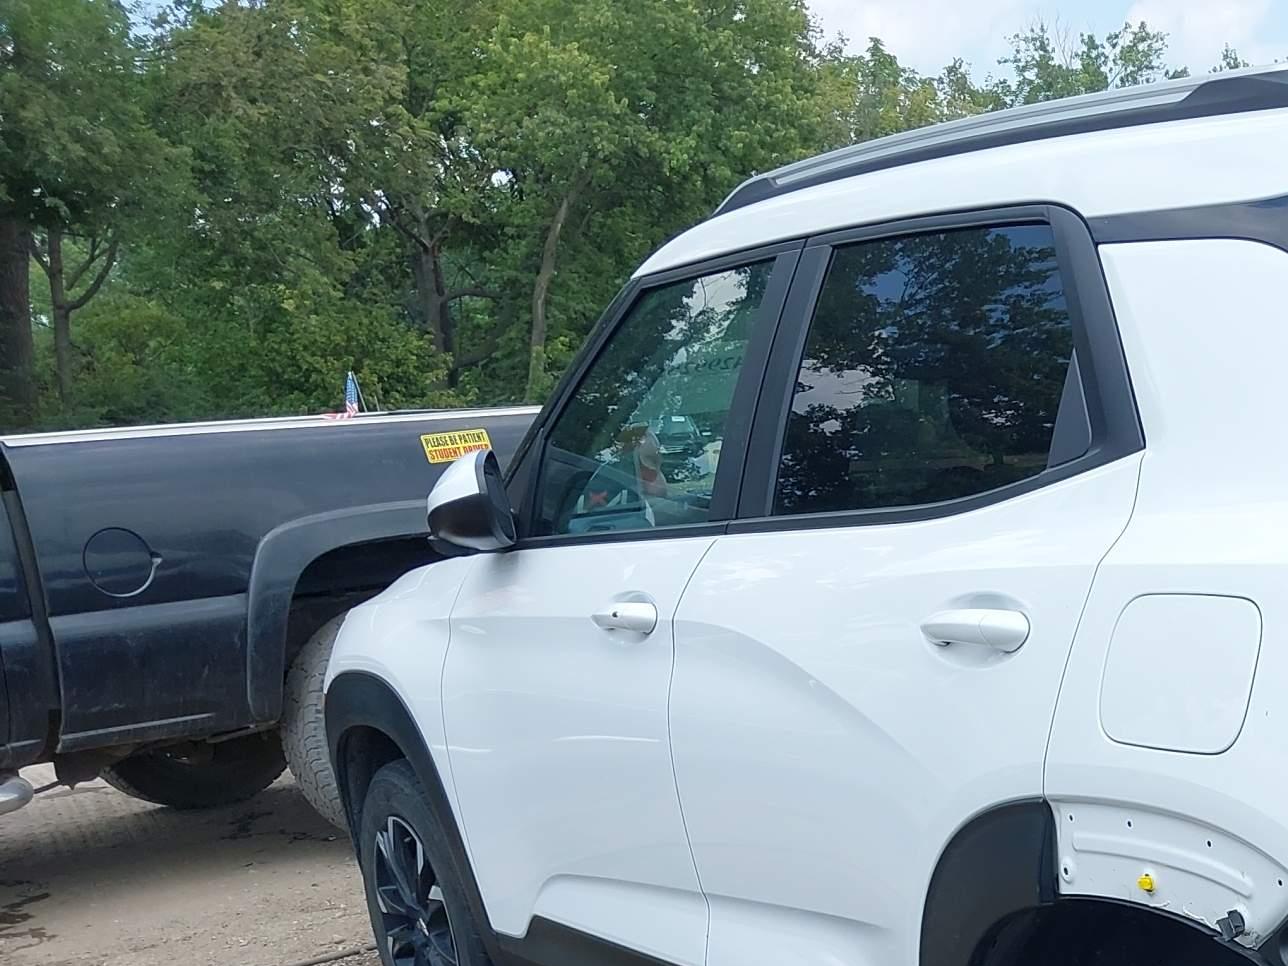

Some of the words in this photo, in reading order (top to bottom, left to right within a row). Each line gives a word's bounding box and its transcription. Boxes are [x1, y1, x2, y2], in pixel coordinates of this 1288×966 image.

[423, 436, 449, 449] PLEASE
[448, 434, 458, 446] BE
[458, 431, 486, 445] PATIENT
[428, 447, 463, 460] STUDENT
